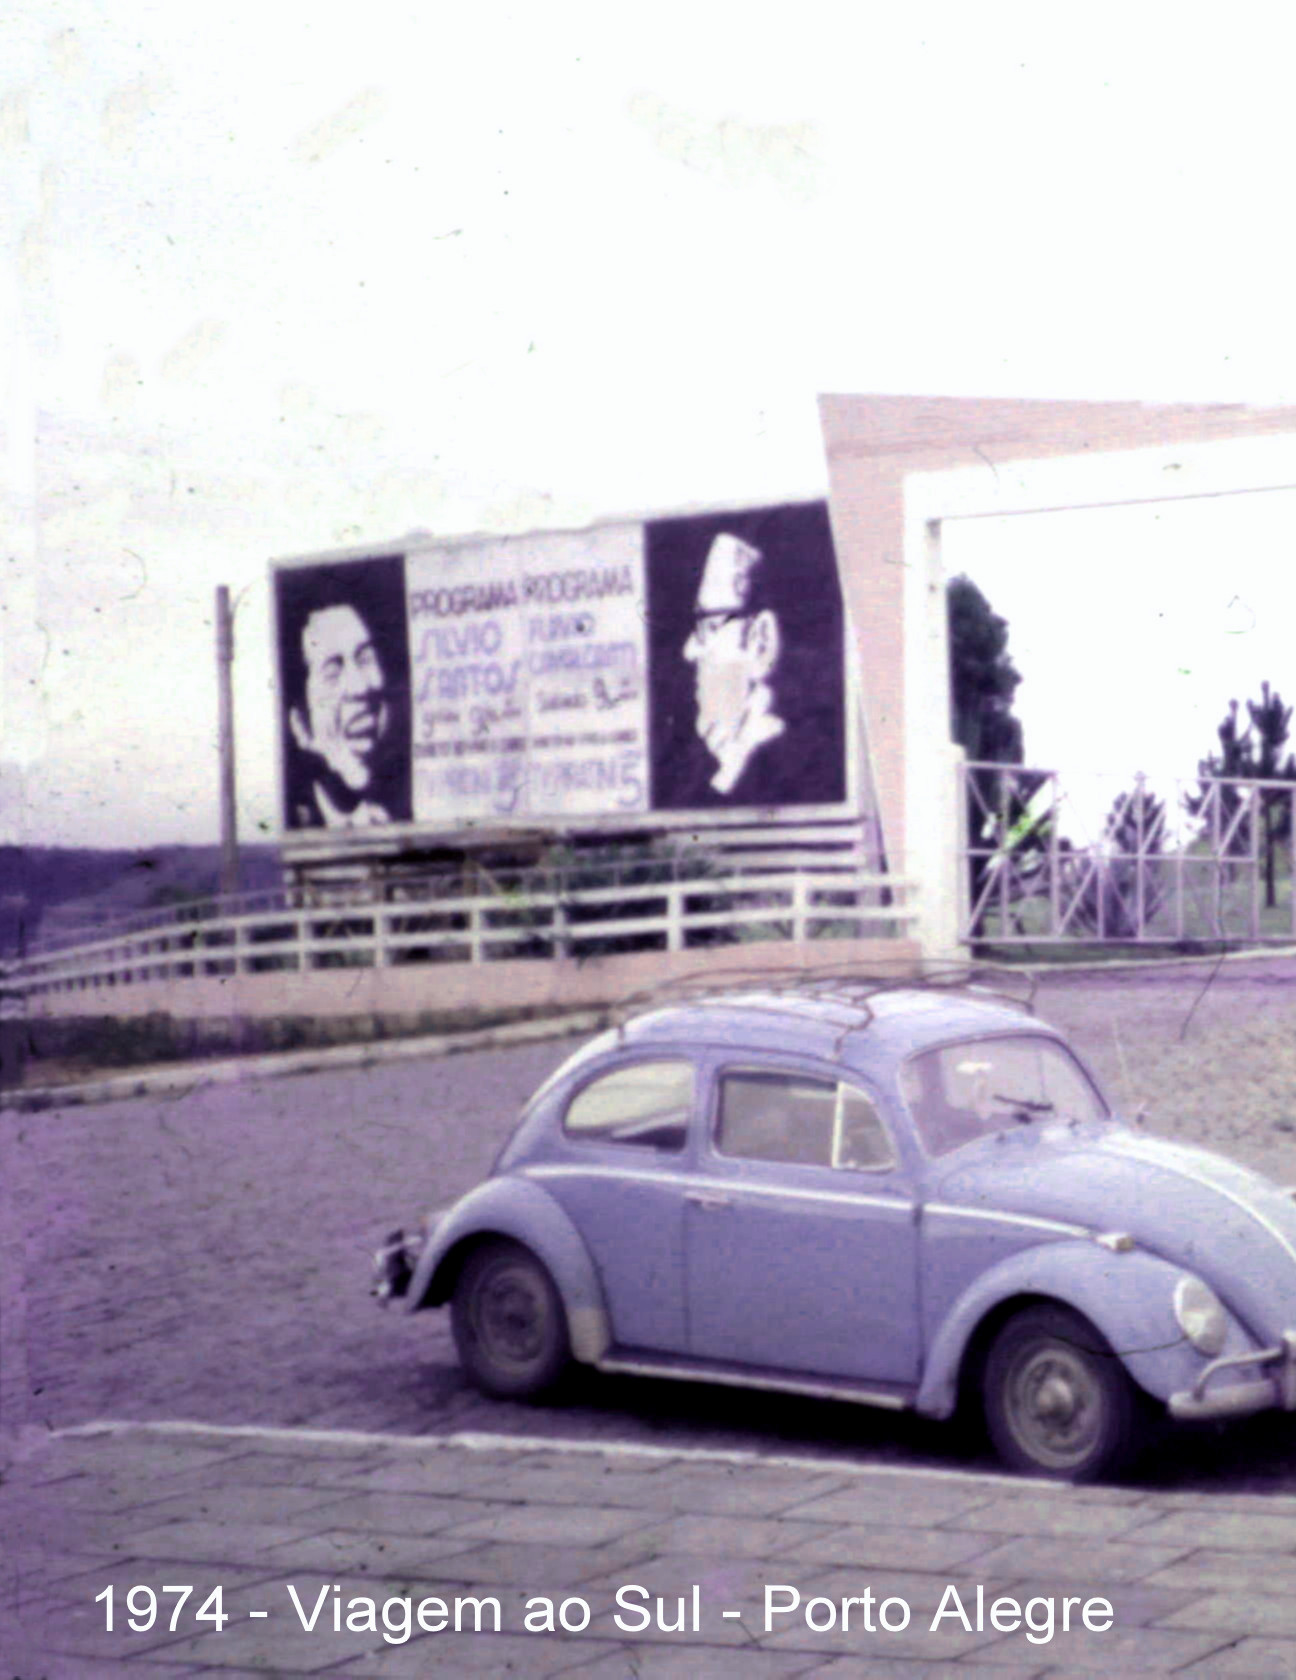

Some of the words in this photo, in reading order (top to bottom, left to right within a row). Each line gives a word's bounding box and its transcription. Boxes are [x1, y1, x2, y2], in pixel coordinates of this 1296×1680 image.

[411, 580, 517, 619] PROGRAMA
[523, 566, 633, 603] PROGRAMA
[415, 620, 501, 664] SILVIO
[416, 660, 520, 704] SANTOS
